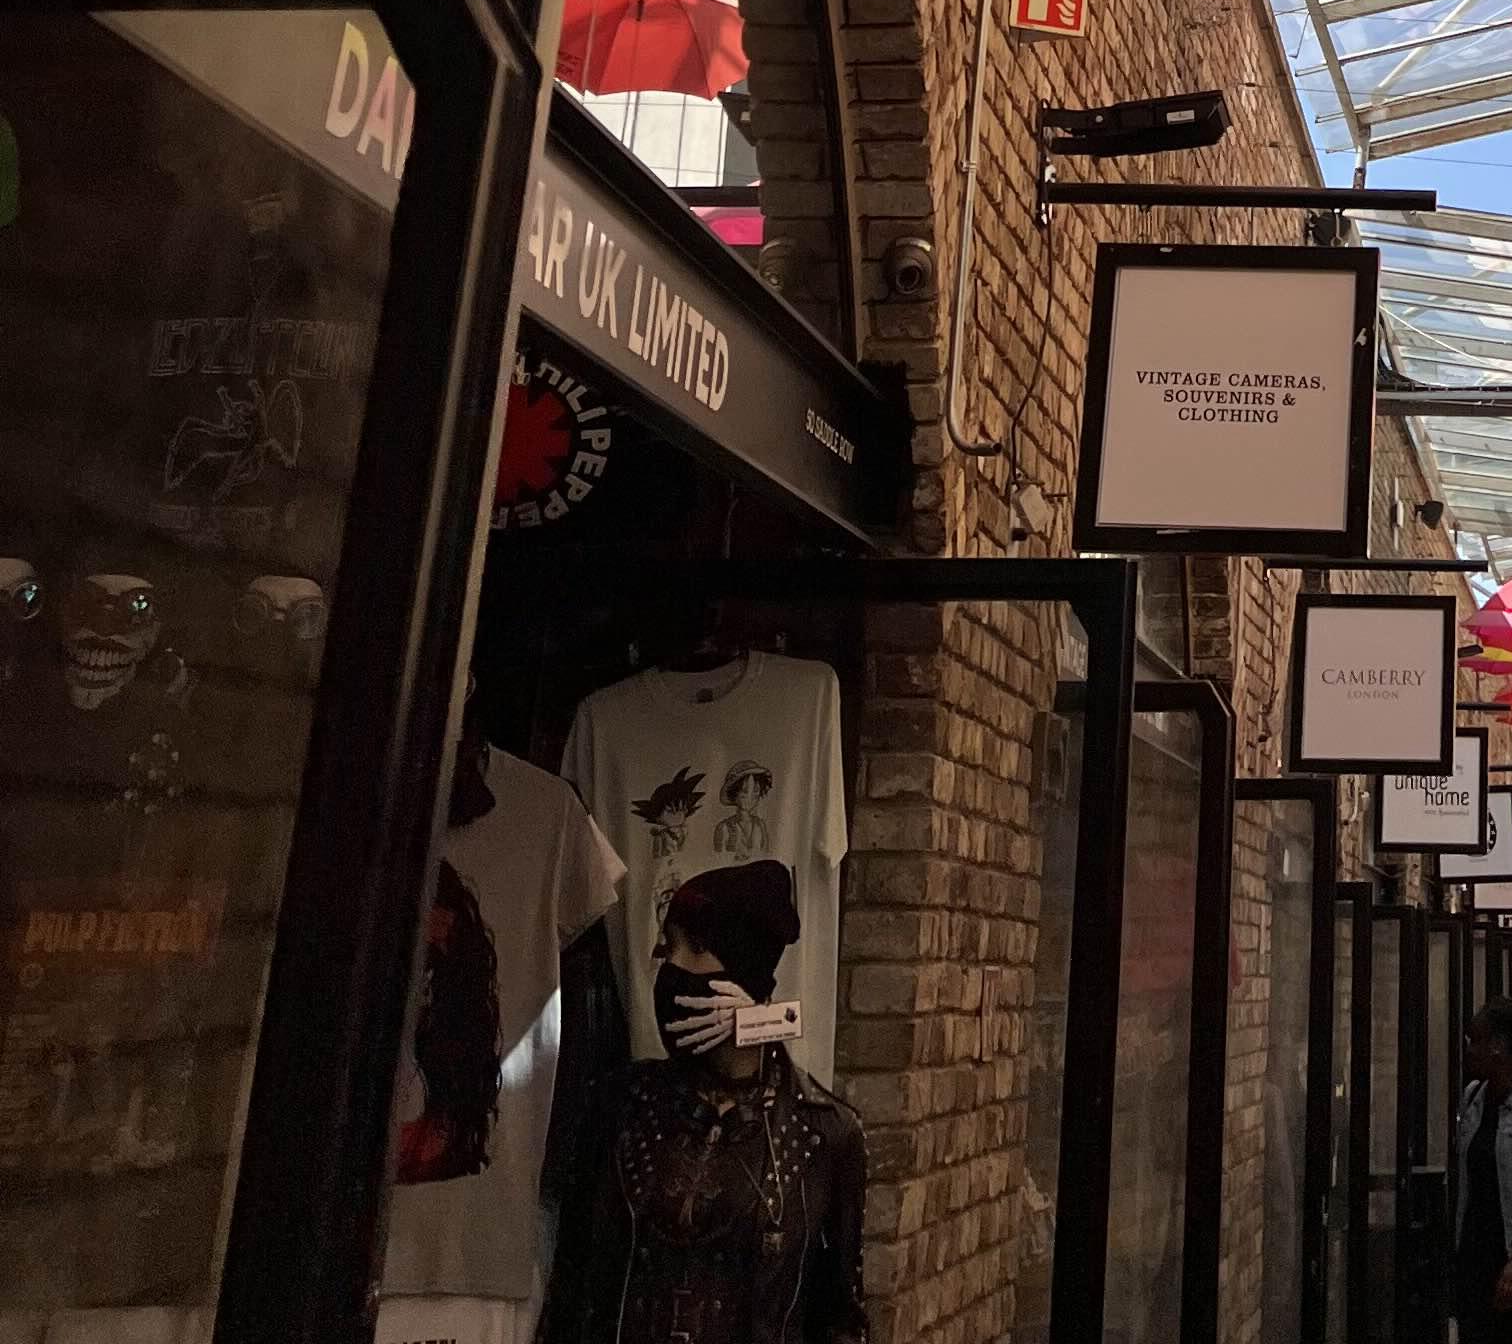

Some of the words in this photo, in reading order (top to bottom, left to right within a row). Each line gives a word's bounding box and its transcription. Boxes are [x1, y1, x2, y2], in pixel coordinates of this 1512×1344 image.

[578, 219, 627, 340] UK
[628, 264, 730, 412] LIMITED
[1136, 370, 1221, 386] VINTAGE
[1228, 372, 1327, 392] CAMERAS,
[1163, 388, 1276, 406] SOUVENIRS
[1282, 392, 1297, 406] &
[1178, 407, 1279, 424] CLOTHING
[1321, 668, 1425, 686] CAMBERRY
[1347, 691, 1399, 700] LONDON
[1394, 774, 1448, 791] unique
[1424, 788, 1470, 806] home
